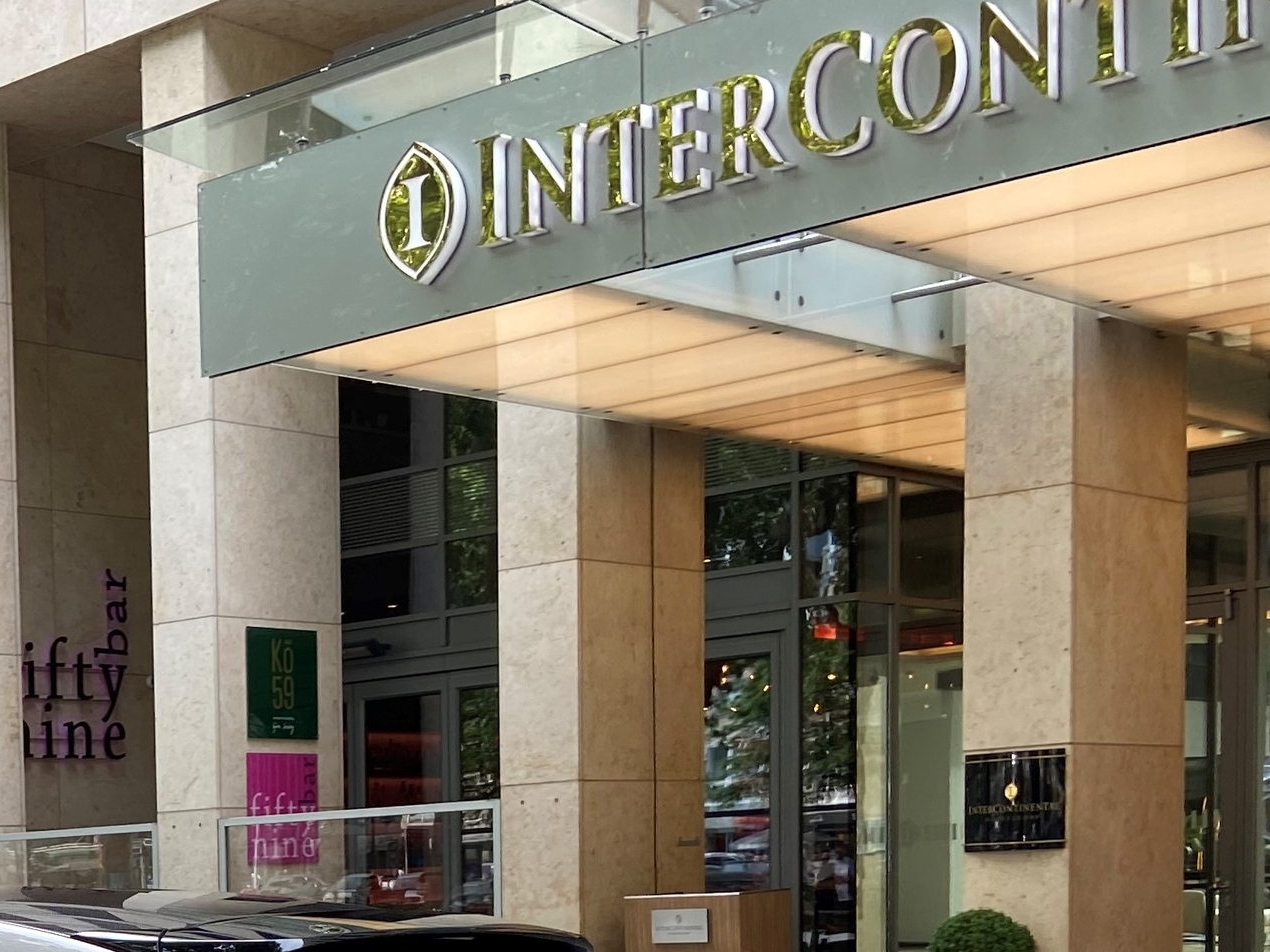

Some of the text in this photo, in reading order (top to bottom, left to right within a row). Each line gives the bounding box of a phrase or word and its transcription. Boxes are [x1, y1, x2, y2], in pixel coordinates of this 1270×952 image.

[94, 568, 128, 658] bar
[23, 636, 127, 722] ifty
[271, 675, 295, 710] 59
[297, 756, 316, 806] bar
[251, 827, 316, 858] nine
